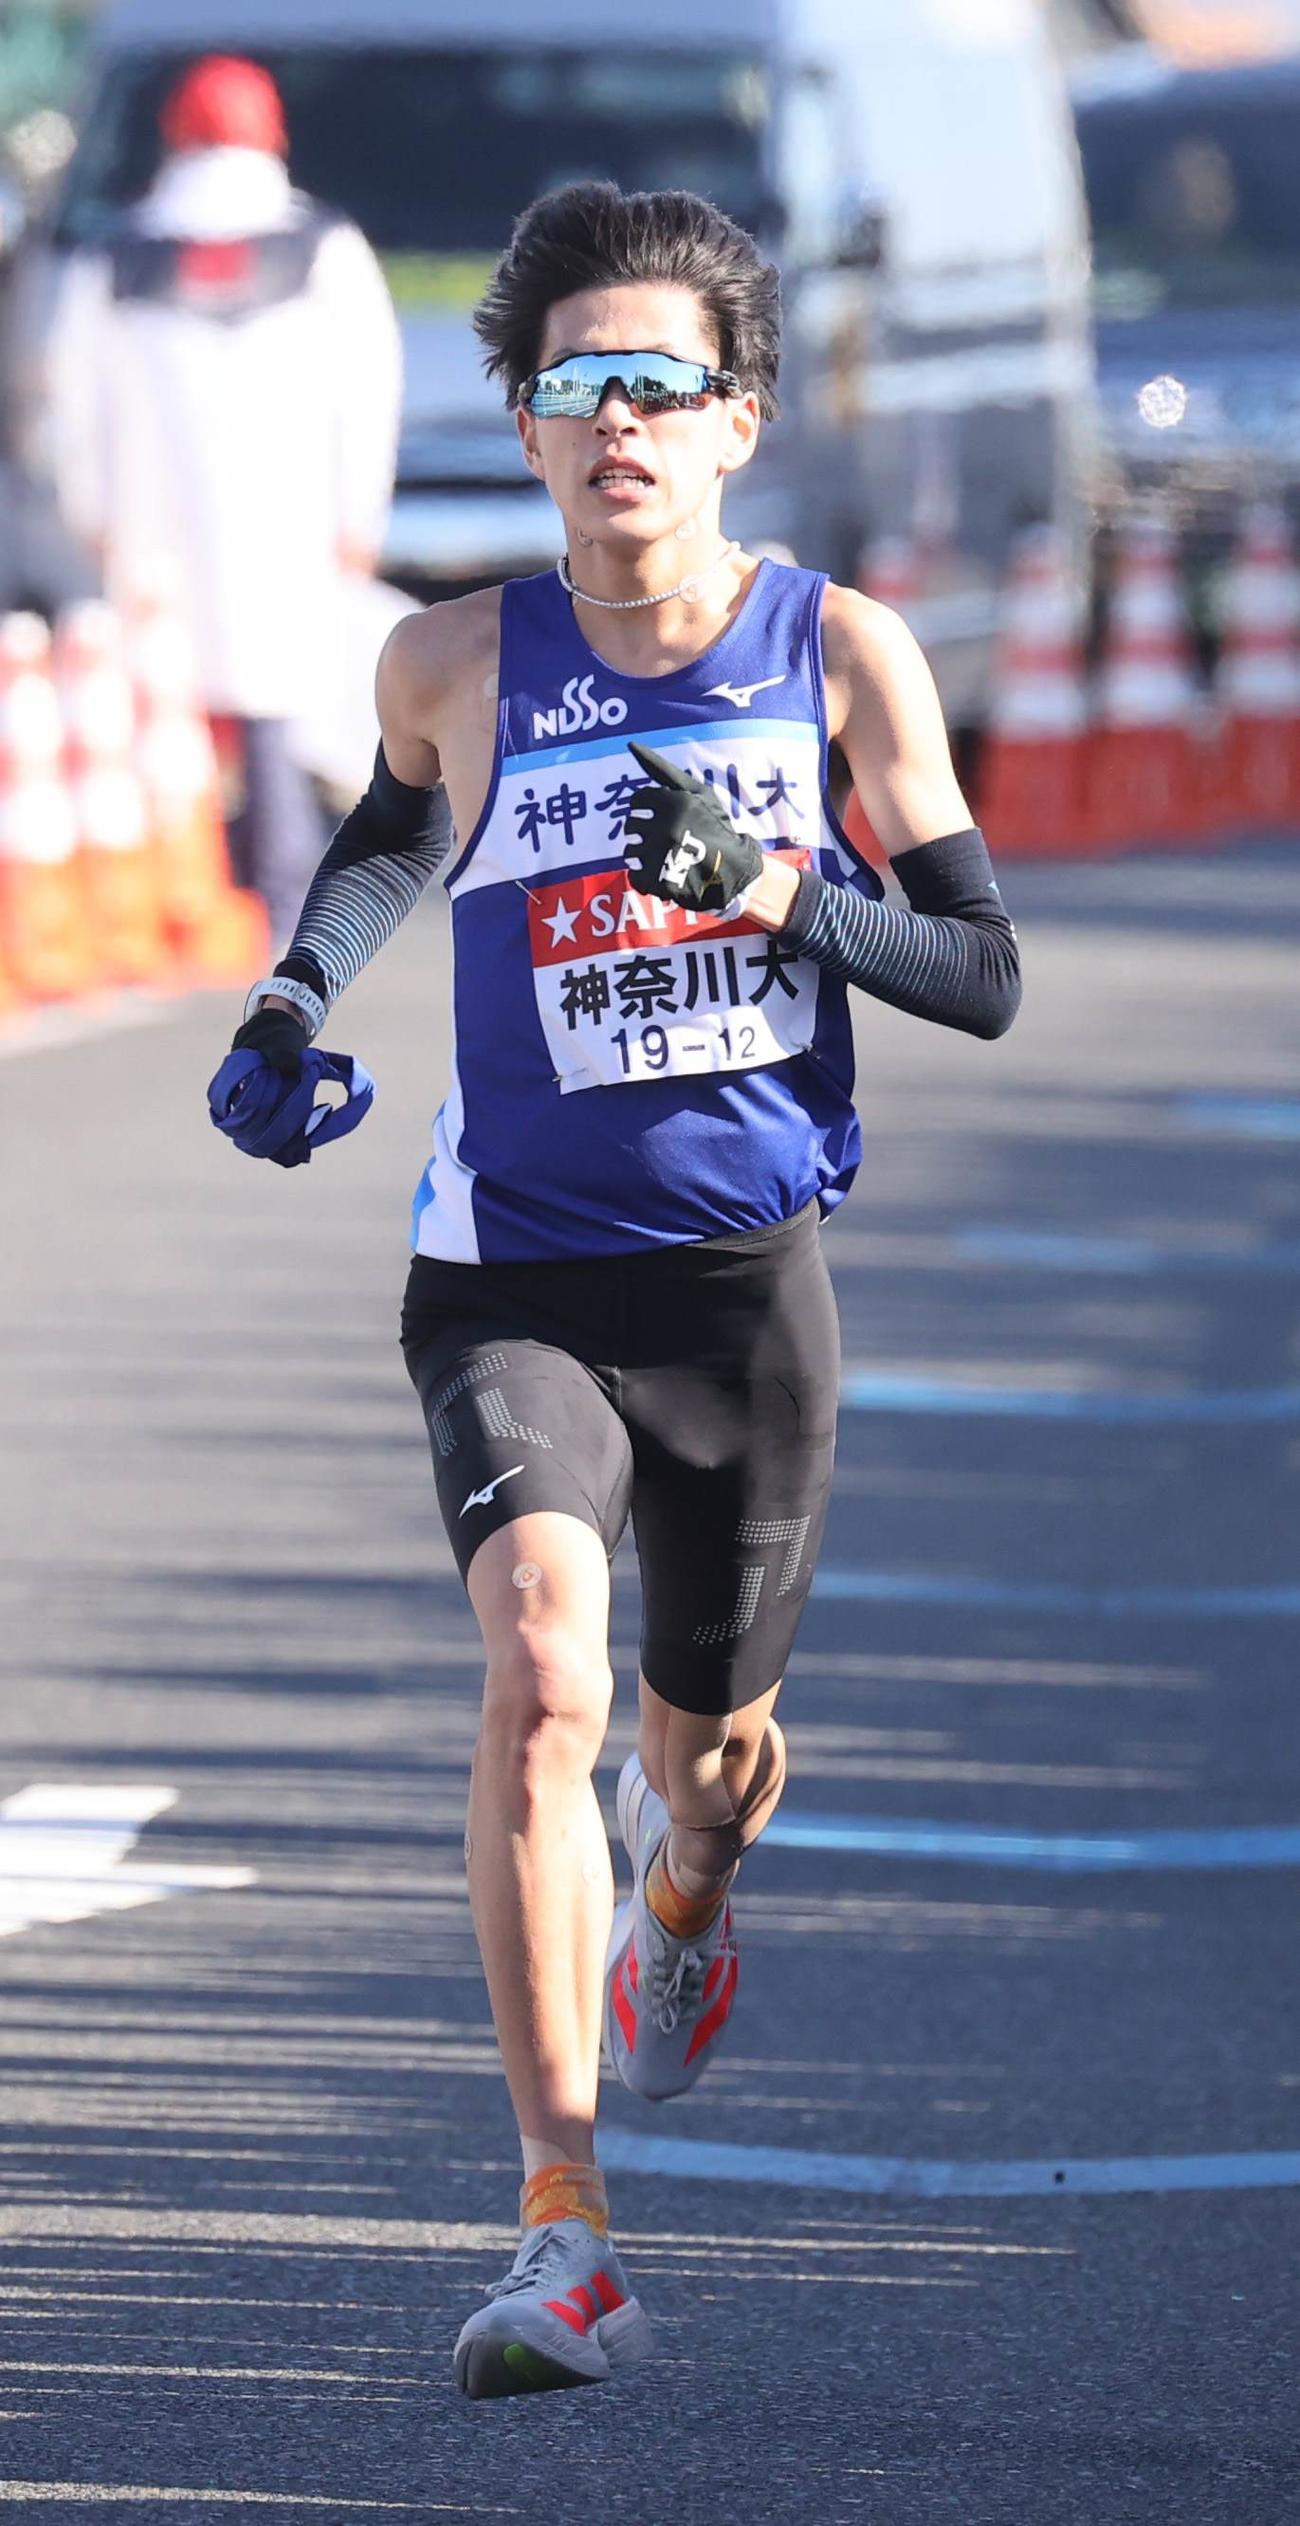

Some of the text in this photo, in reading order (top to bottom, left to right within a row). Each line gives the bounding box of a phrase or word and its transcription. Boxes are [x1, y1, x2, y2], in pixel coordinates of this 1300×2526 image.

[533, 674, 628, 740] NISSO
[559, 939, 799, 1031] 神奈川大
